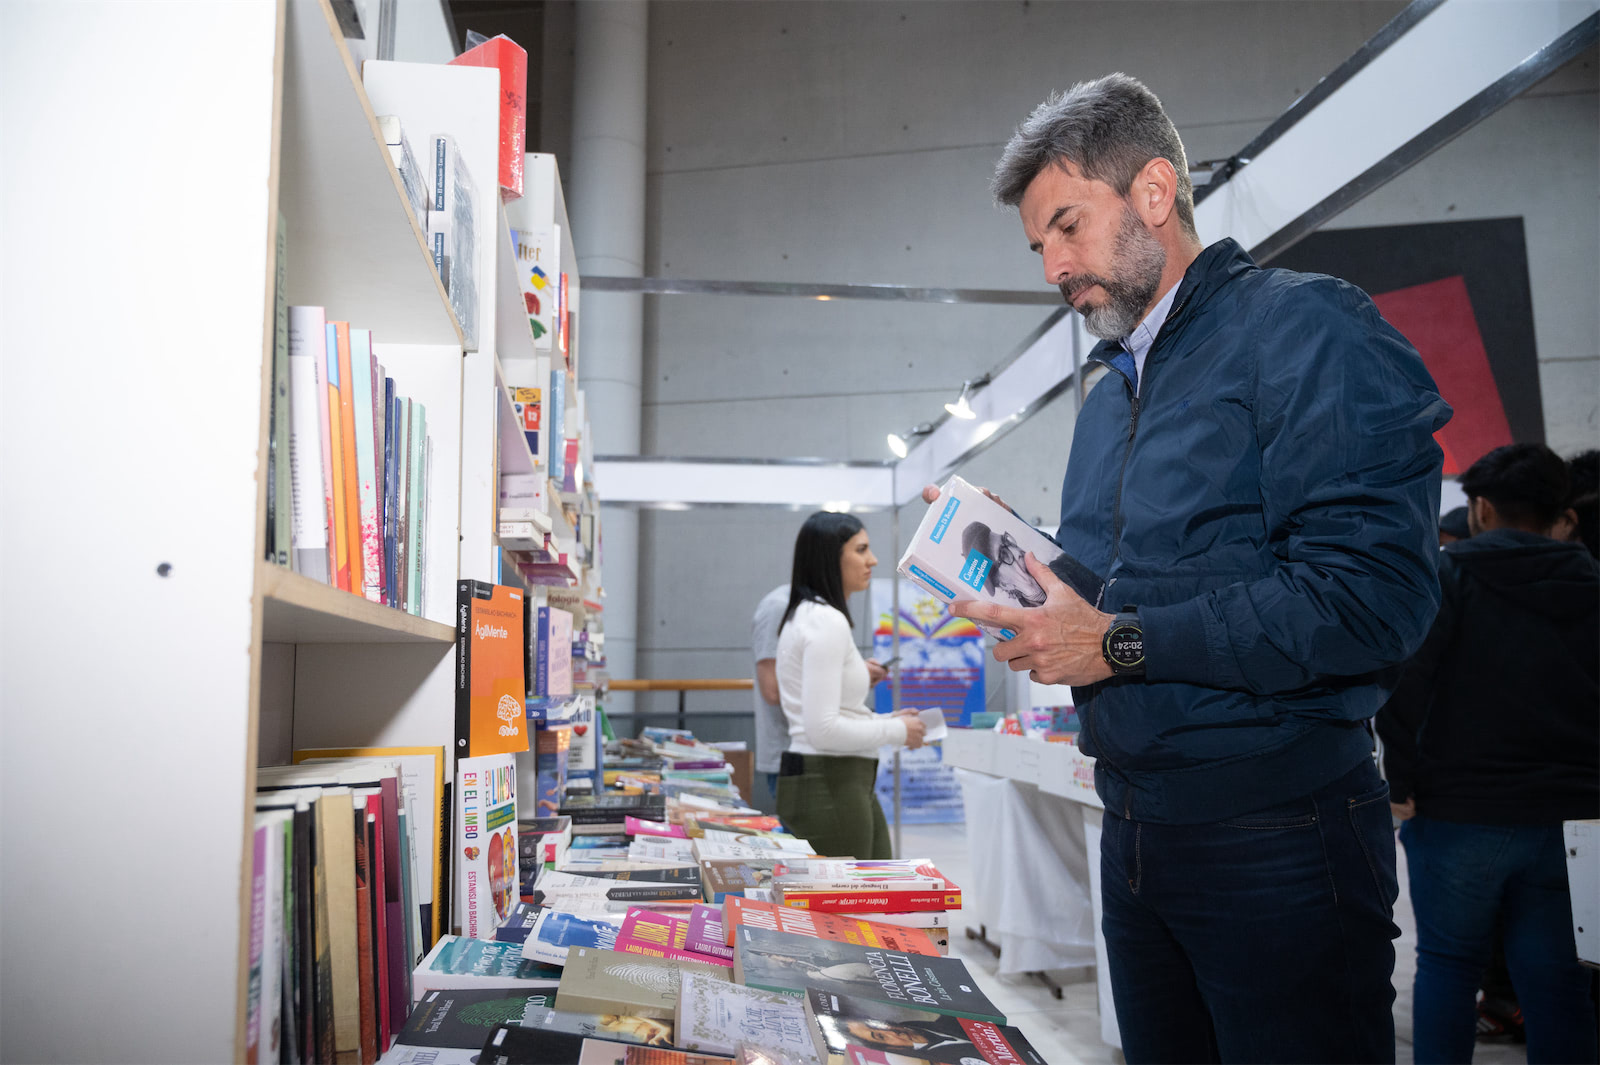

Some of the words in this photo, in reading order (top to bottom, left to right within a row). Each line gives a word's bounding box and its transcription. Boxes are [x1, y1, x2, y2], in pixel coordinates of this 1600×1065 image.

[964, 558, 979, 582] Cuentos
[972, 559, 988, 588] completos
[459, 604, 468, 633] ÁgilMente
[475, 619, 508, 640] ÁgilMente
[1118, 641, 1142, 650] 20:24
[464, 773, 477, 786] EN
[464, 790, 477, 803] EL
[464, 806, 478, 839] LIMBO
[468, 871, 477, 910] ESTANISLAO
[625, 943, 642, 953] LAURA
[643, 947, 665, 958] GUTMAN
[695, 942, 712, 953] LAURA
[712, 946, 734, 958] GUTMAN
[865, 951, 906, 1000] FLORENCIA
[886, 953, 940, 1007] BONELLI
